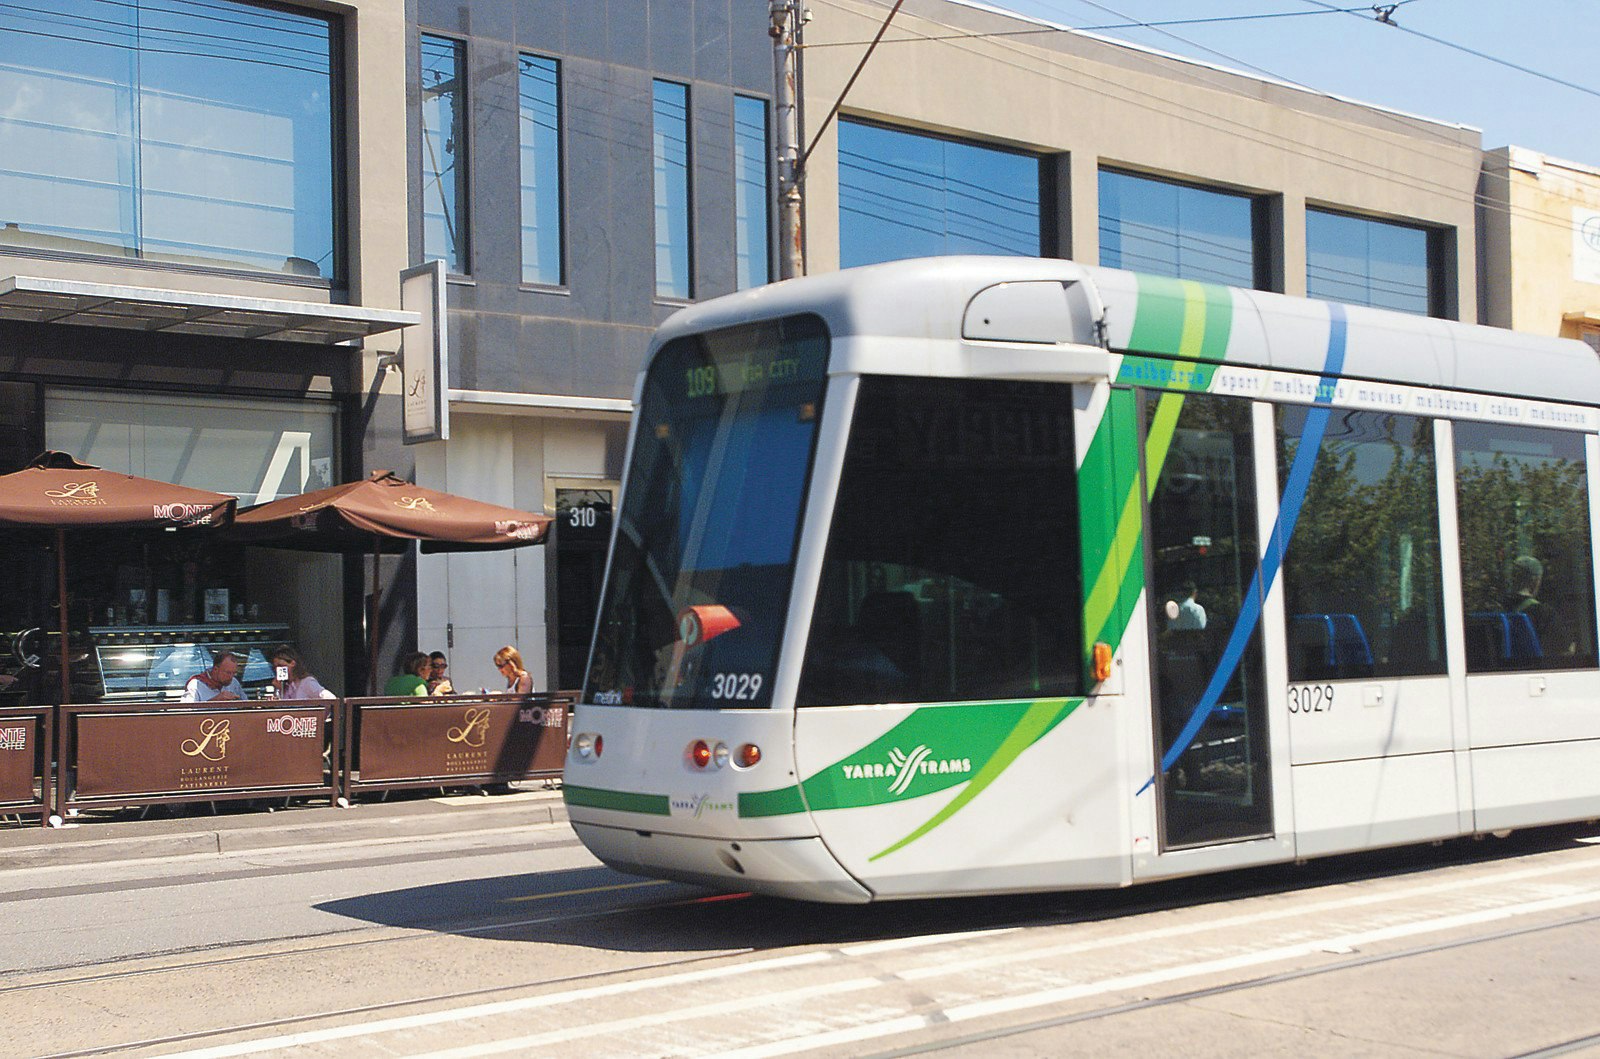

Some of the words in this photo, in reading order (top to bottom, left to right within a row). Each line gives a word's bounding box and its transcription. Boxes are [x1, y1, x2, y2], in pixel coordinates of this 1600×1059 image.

[686, 365, 715, 398] 109
[1120, 362, 1204, 385] melbourne
[1222, 375, 1258, 391] sport
[1273, 378, 1343, 398] melbourne
[1359, 389, 1401, 404] movies
[1417, 393, 1478, 412] melbourne
[569, 507, 596, 527] 310
[711, 673, 762, 700] 3029
[1288, 685, 1334, 714] 3029
[266, 715, 317, 735] MONTE
[0, 742, 25, 750] OFFEE
[181, 765, 229, 775] LAURENT
[842, 763, 896, 779] YARRA
[919, 758, 971, 775] TRAMS
